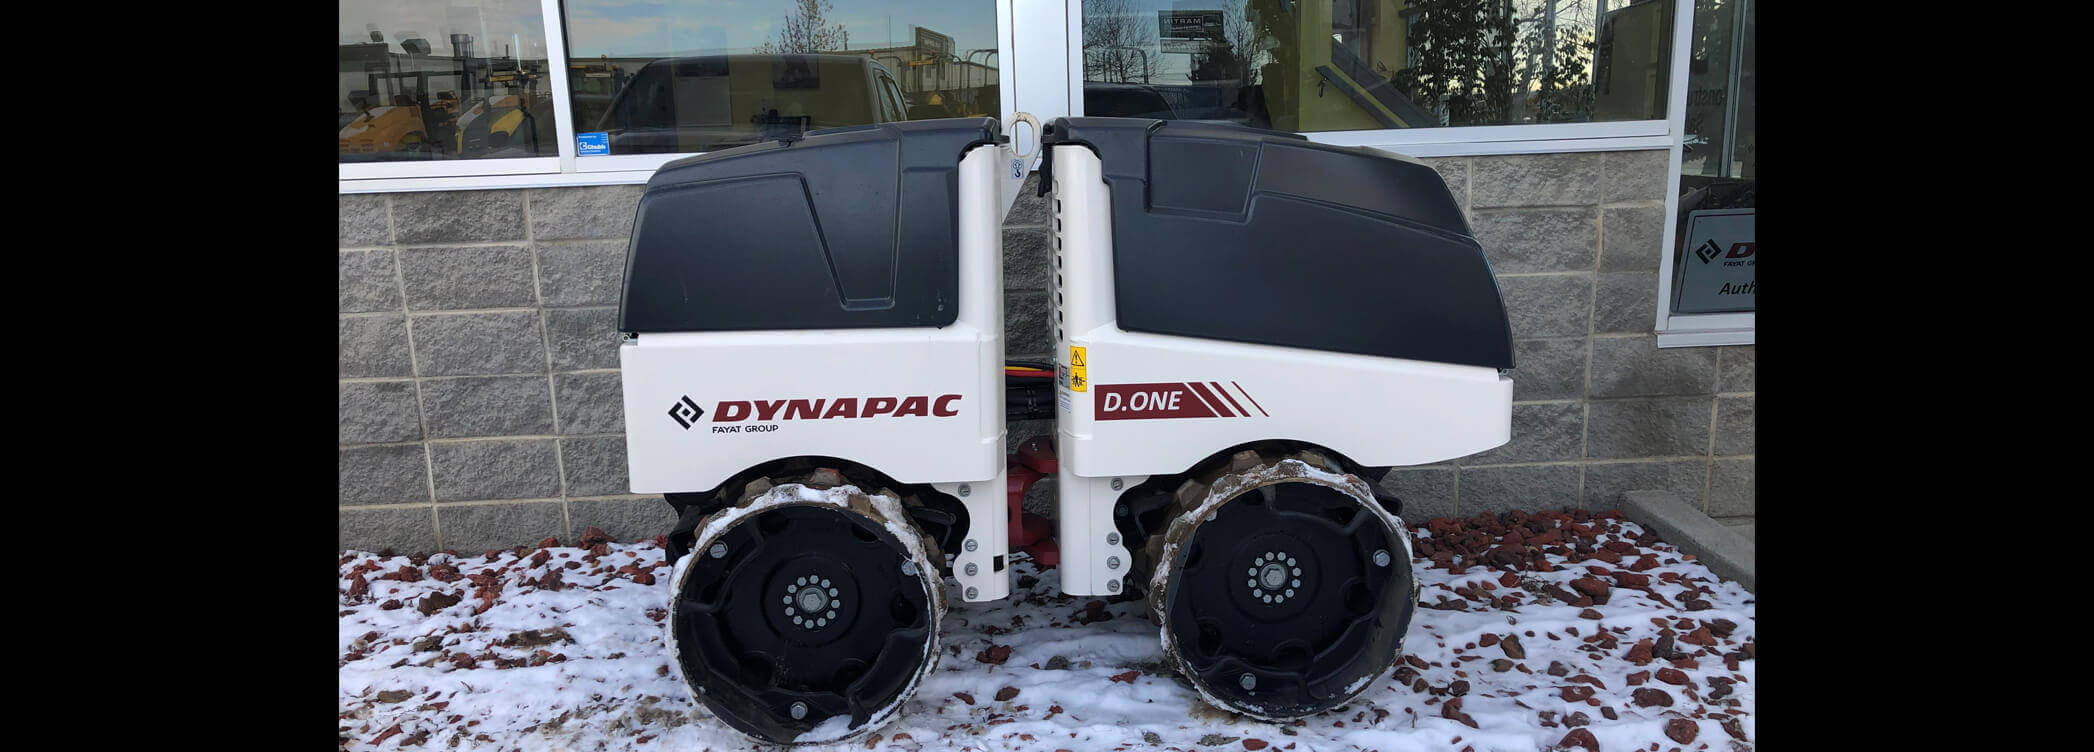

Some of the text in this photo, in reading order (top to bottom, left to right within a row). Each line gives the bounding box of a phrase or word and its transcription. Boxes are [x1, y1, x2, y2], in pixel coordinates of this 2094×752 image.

[712, 394, 963, 422] DYNAPAC
[1103, 390, 1183, 412] D.ONE
[712, 425, 779, 434] FAYAT GROUP
